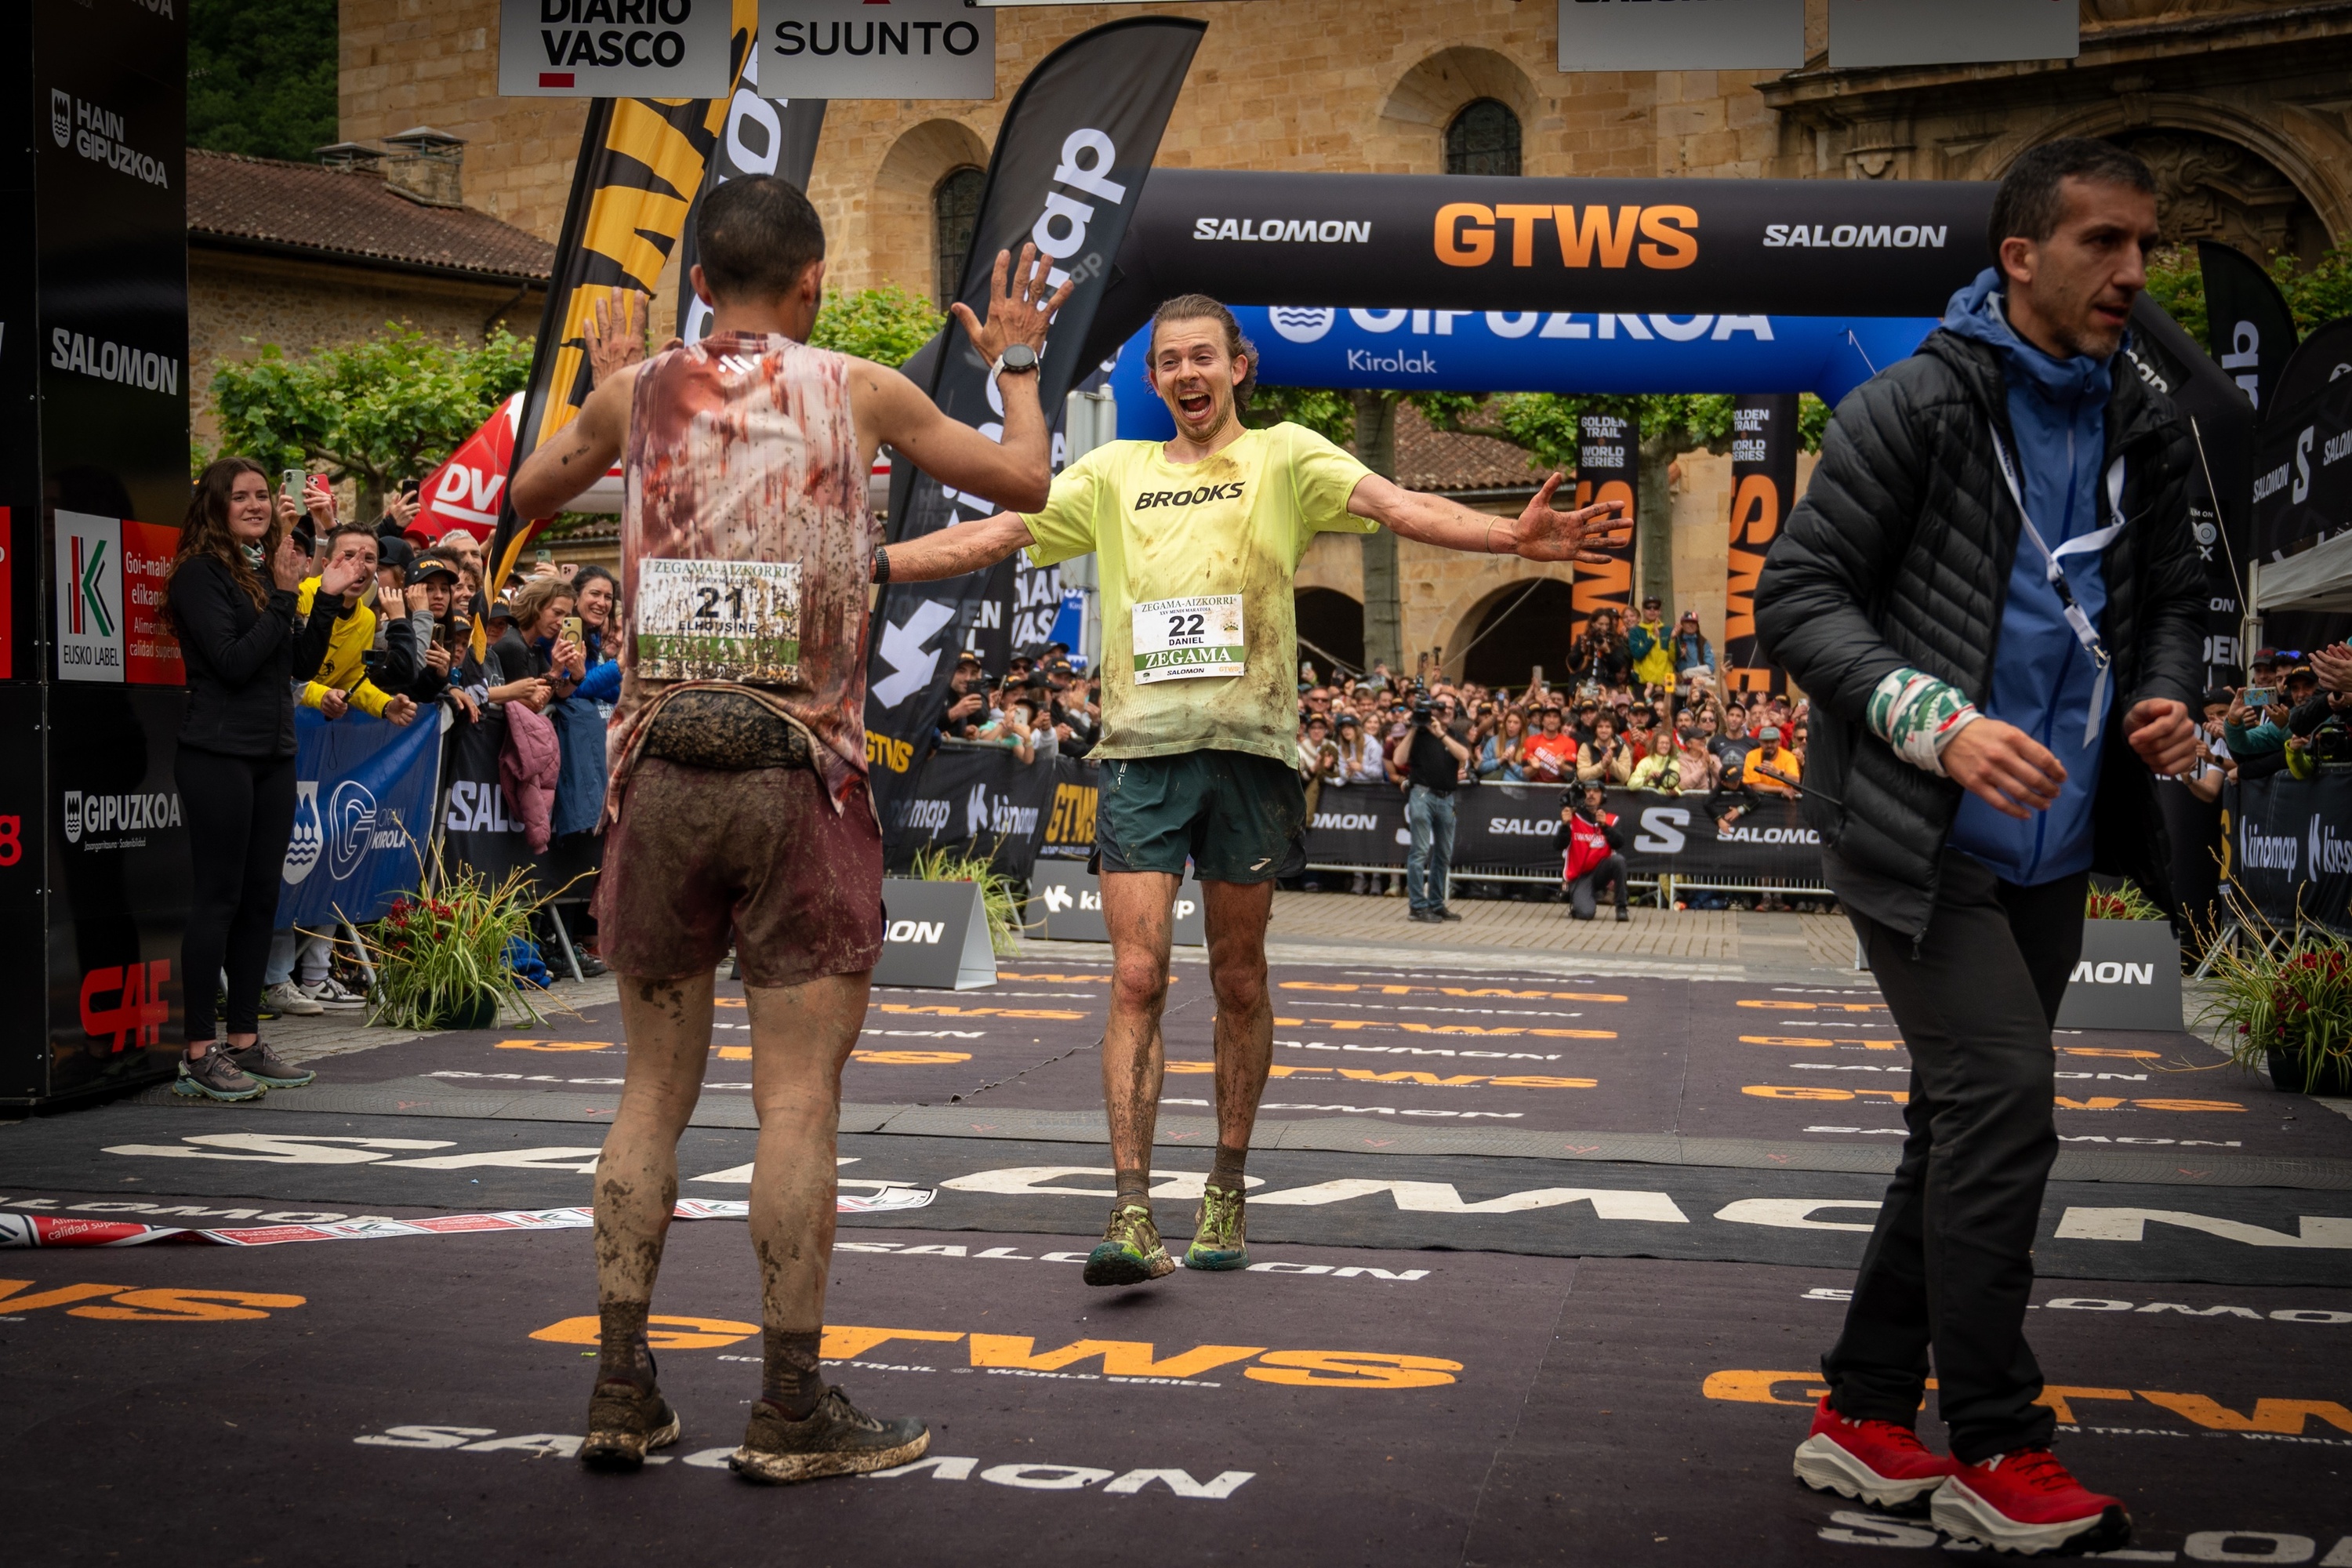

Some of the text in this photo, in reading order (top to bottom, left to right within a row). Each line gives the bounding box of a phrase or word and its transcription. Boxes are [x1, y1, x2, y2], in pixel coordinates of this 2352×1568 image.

[541, 30, 686, 67] VASCO
[774, 21, 980, 56] SUUNTO
[77, 98, 124, 143] HAIN
[76, 129, 169, 190] GIPUZKOA
[1192, 218, 1371, 243] SALOMON
[1434, 202, 1700, 270] GTWS
[1762, 224, 1947, 248] SALOMON
[51, 327, 178, 396] SALOMON
[1348, 349, 1437, 374] Kirolak
[1585, 427, 1621, 438] TRAIL
[1581, 445, 1625, 457] WORLD
[1581, 456, 1625, 468] SERIES
[435, 463, 506, 512] DV
[2252, 462, 2290, 503] SALOMON
[1134, 481, 1247, 511] BROOKS
[695, 587, 743, 619] 21
[1141, 596, 1234, 613] ZEGAMA-AIZKORRI
[1168, 614, 1205, 637] 22
[129, 639, 154, 659] calidad
[1168, 637, 1205, 646] DANIEL
[64, 644, 120, 666] EUSKO LABEL
[1145, 647, 1232, 669] ZEGAMA
[1167, 667, 1205, 676] SALOMON
[83, 792, 182, 833] GIPUZKOA
[1488, 817, 1562, 837] SALO
[1716, 826, 1821, 845] SALOMO
[2247, 823, 2298, 883] kinomap
[851, 1361, 937, 1372] TRAIL
[986, 1369, 1098, 1379] WORLD
[1106, 1377, 1221, 1388] SERIES
[2087, 1427, 2190, 1438] TRAIL
